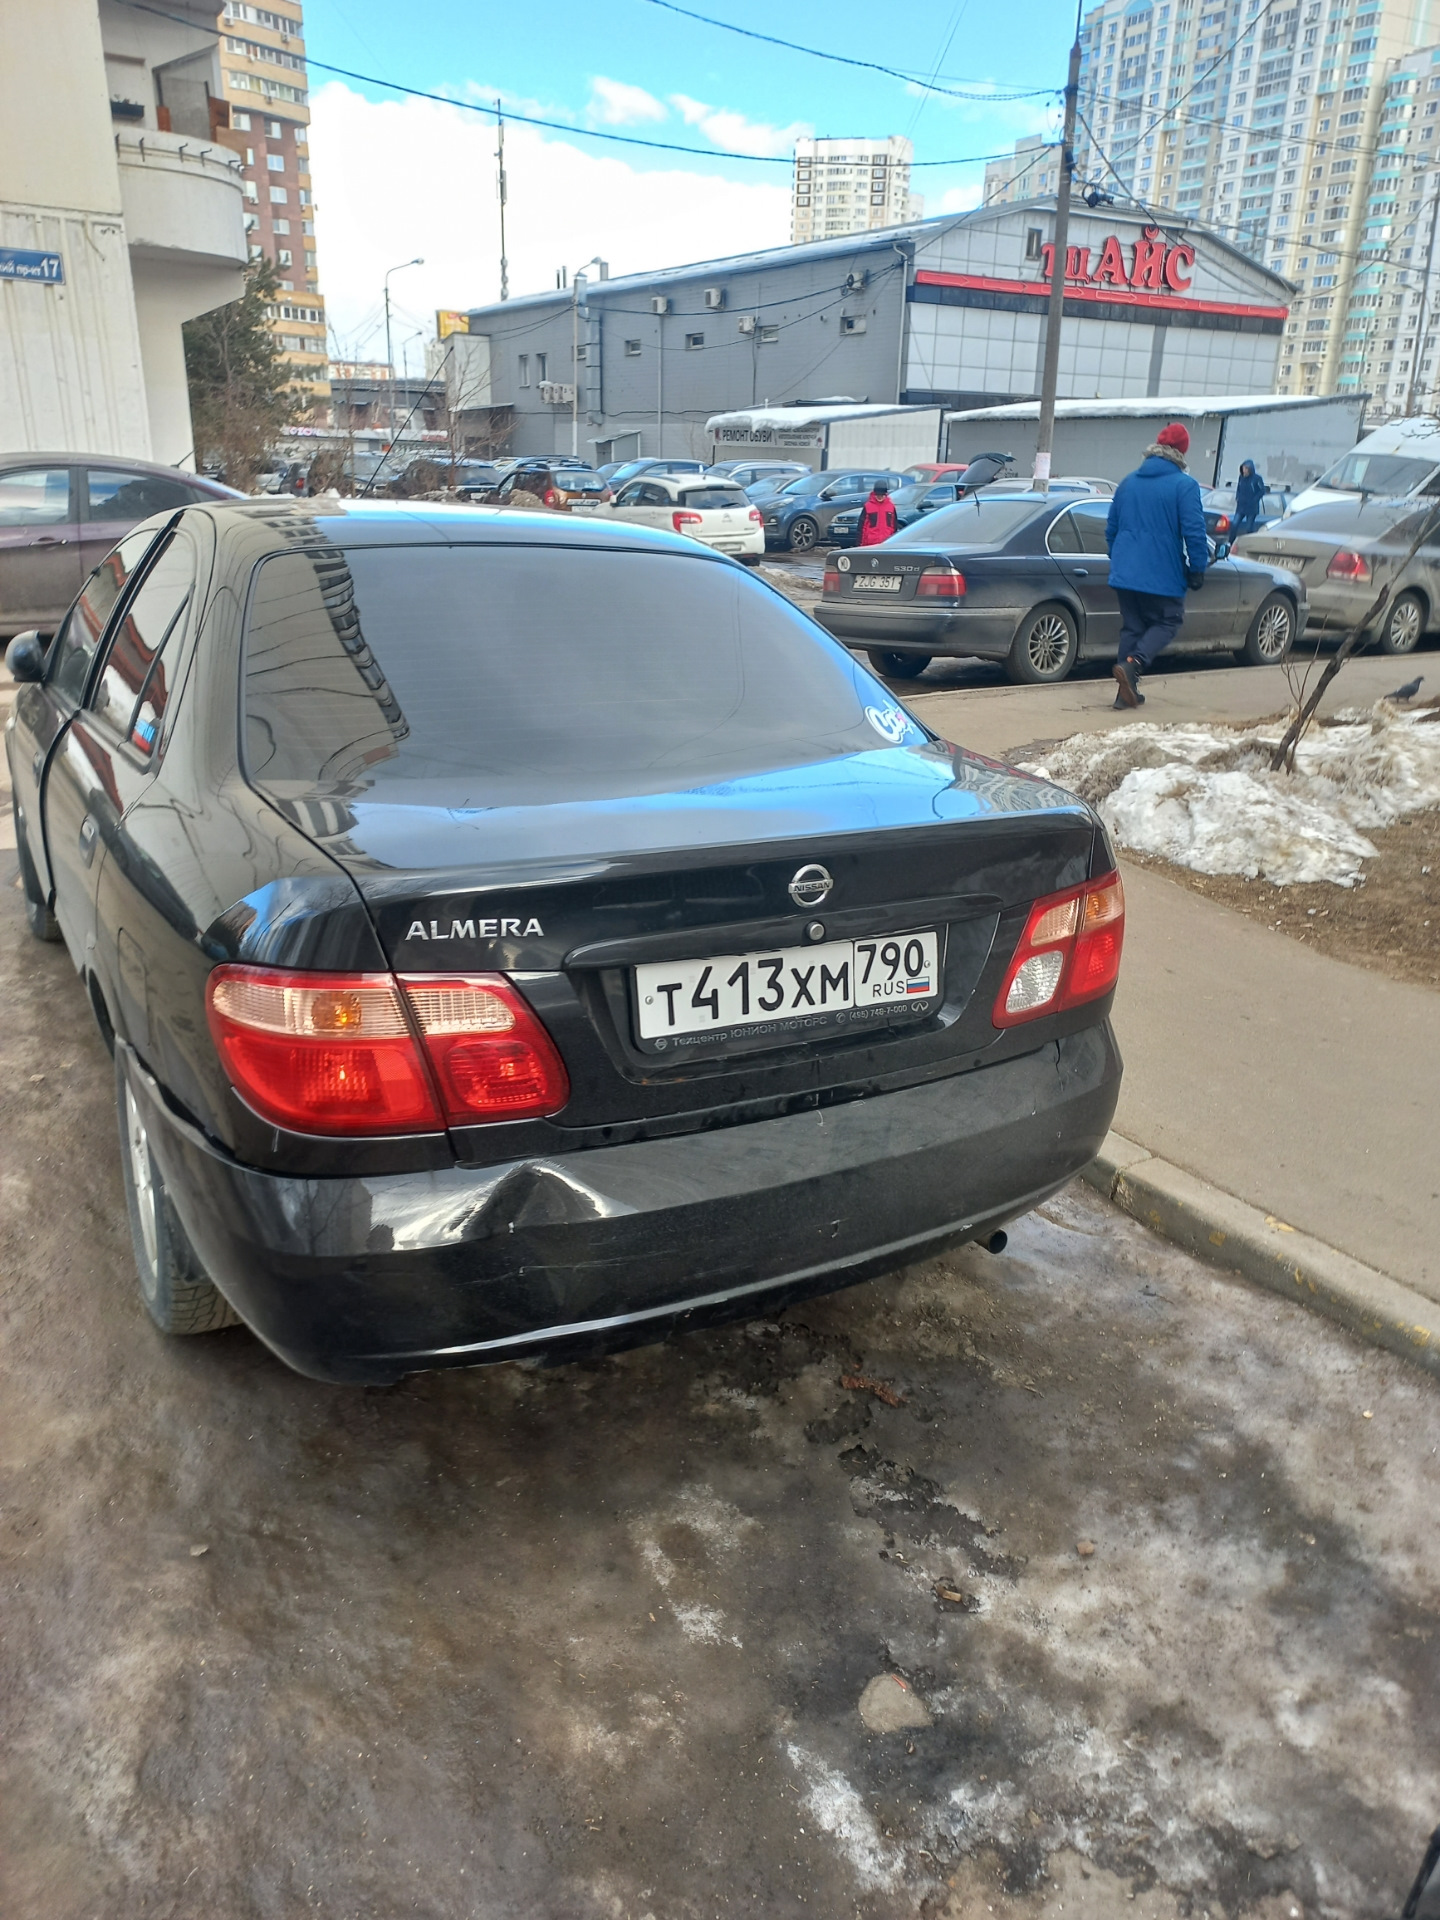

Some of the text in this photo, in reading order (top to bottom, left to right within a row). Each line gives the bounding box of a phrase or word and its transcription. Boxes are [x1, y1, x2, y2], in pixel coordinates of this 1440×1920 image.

[41, 256, 60, 278] 17
[722, 429, 749, 442] РЕМОНТ
[749, 429, 773, 443] ОБУВИ
[858, 574, 896, 588] ZJG 351
[793, 882, 831, 892] NISSAN
[404, 917, 545, 941] ALMERA
[656, 938, 924, 1027] Т413ХМ 790
[872, 980, 905, 998] RUS
[672, 1015, 829, 1047] Техцентр ЮНИОН МОТОРС
